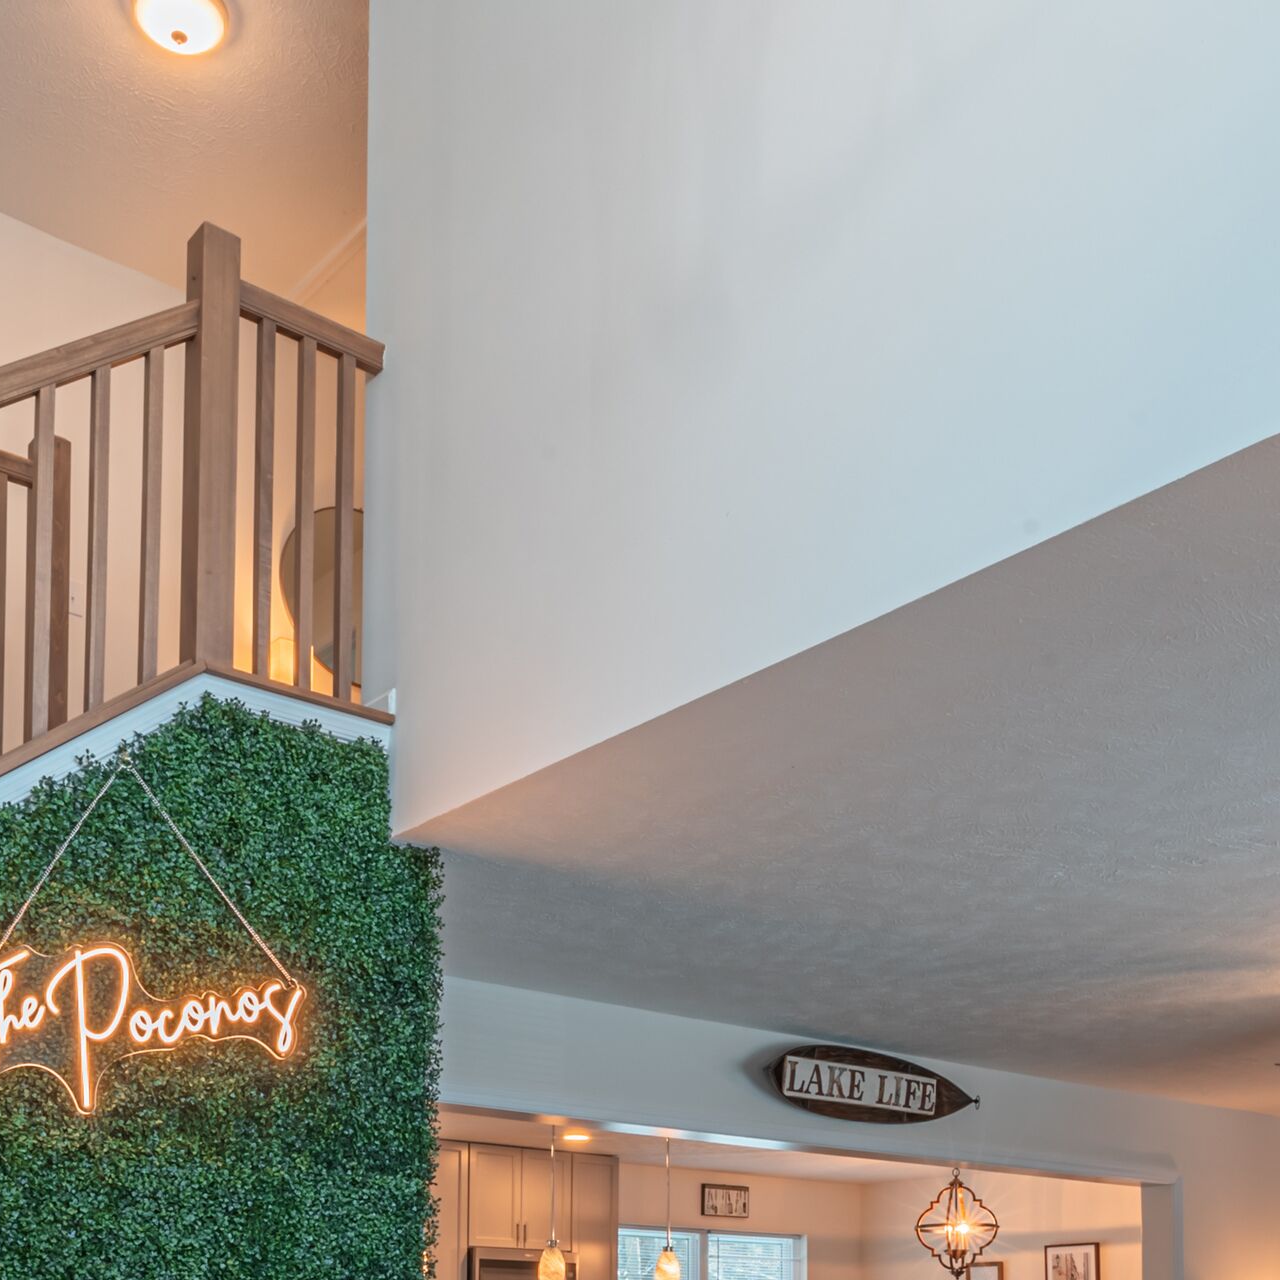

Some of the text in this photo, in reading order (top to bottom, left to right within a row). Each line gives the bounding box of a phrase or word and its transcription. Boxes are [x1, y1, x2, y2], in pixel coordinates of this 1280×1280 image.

[45, 946, 303, 1108] Poconos
[786, 1060, 936, 1112] LAKE LIFE
